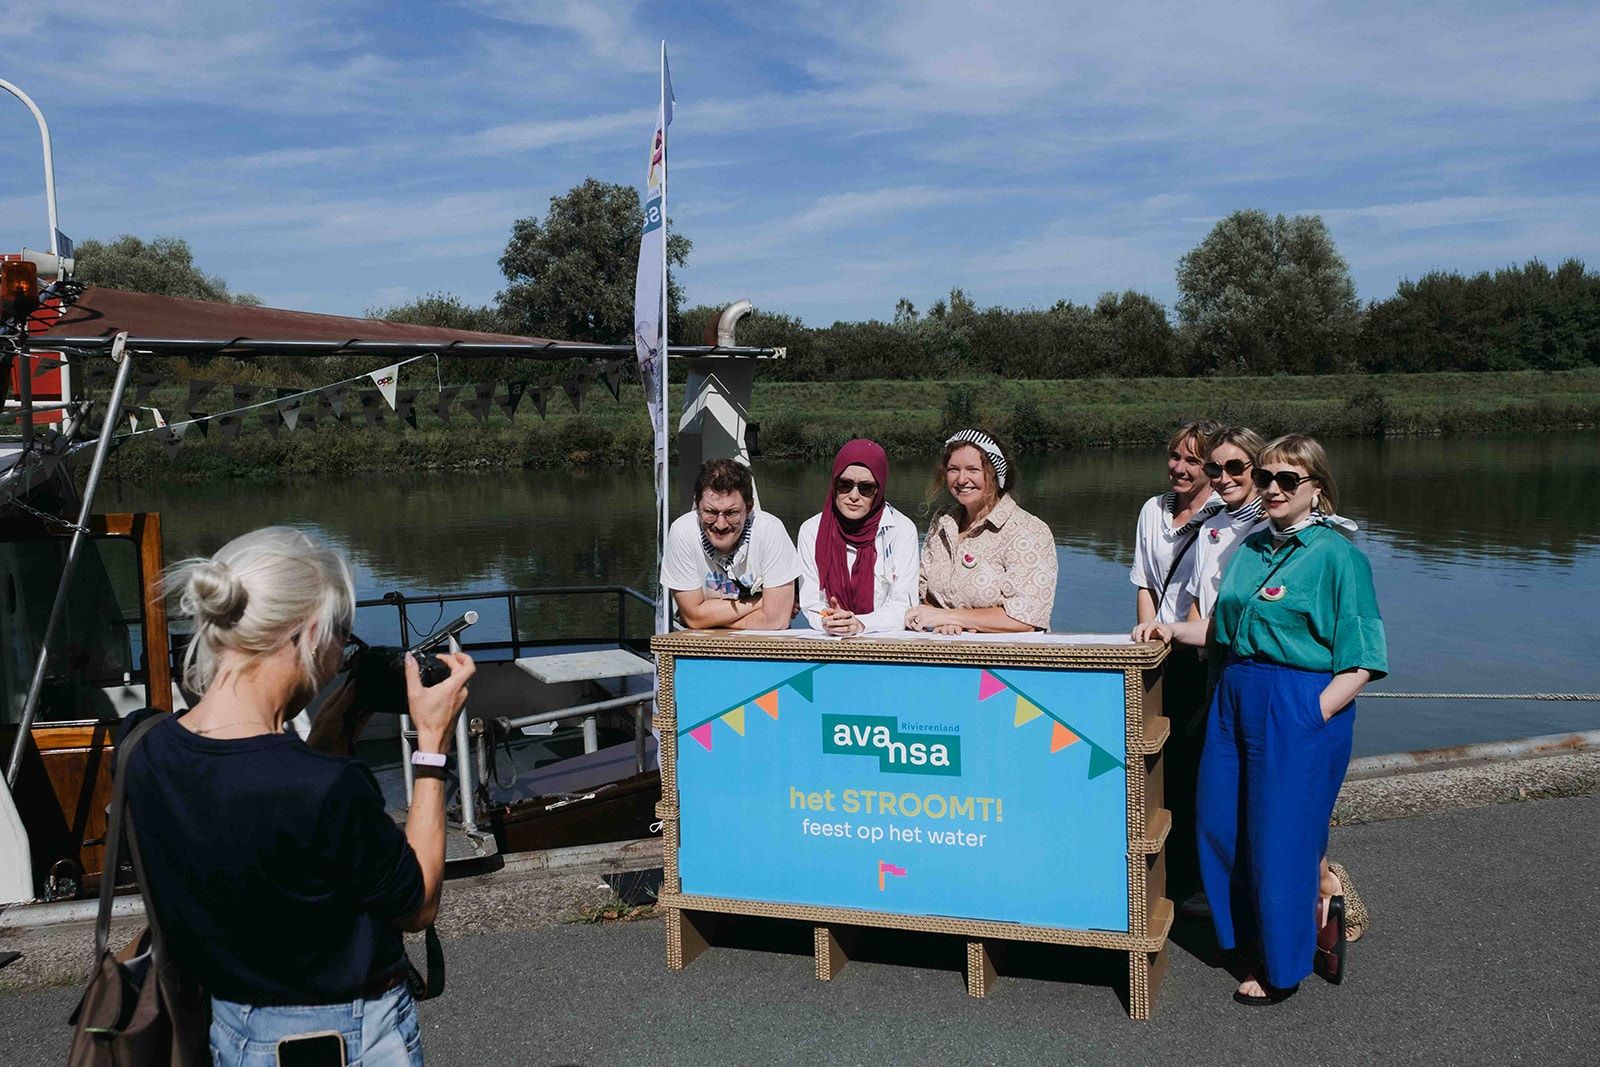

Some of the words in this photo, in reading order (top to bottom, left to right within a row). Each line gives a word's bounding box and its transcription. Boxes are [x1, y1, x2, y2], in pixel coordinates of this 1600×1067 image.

[901, 722, 960, 733] Rivierenland
[833, 724, 950, 767] avansa
[789, 786, 836, 811] het
[842, 788, 1003, 823] STROOMT!
[802, 818, 852, 838] feest
[857, 826, 884, 844] op
[889, 824, 922, 843] het
[927, 829, 987, 847] water
